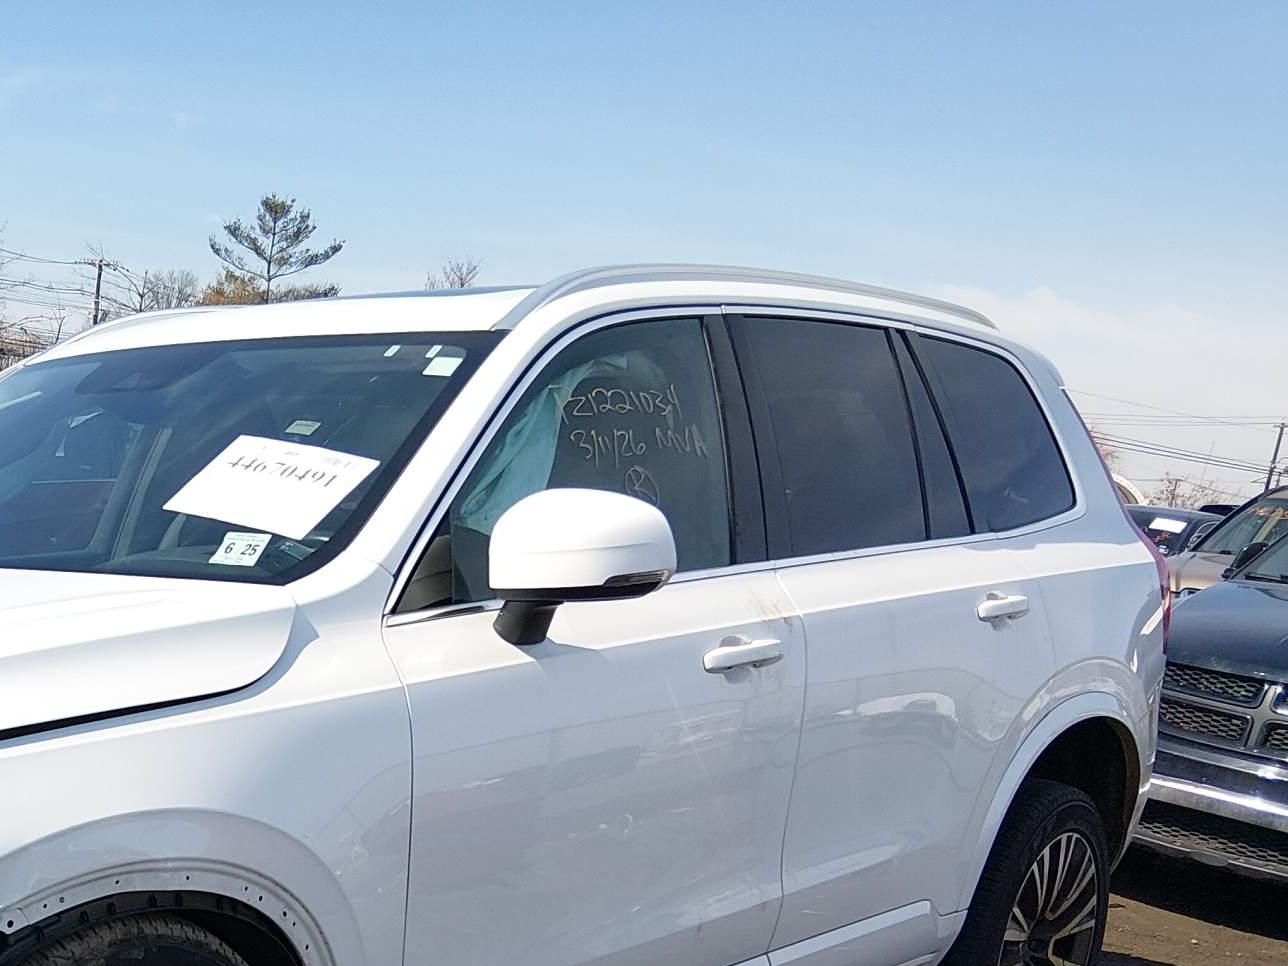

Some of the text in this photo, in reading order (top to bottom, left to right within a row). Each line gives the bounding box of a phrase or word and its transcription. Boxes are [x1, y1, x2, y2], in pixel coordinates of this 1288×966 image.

[569, 423, 710, 468] 3/11/26 MVA
[227, 455, 338, 488] 44670491
[224, 542, 260, 556] 6 25
